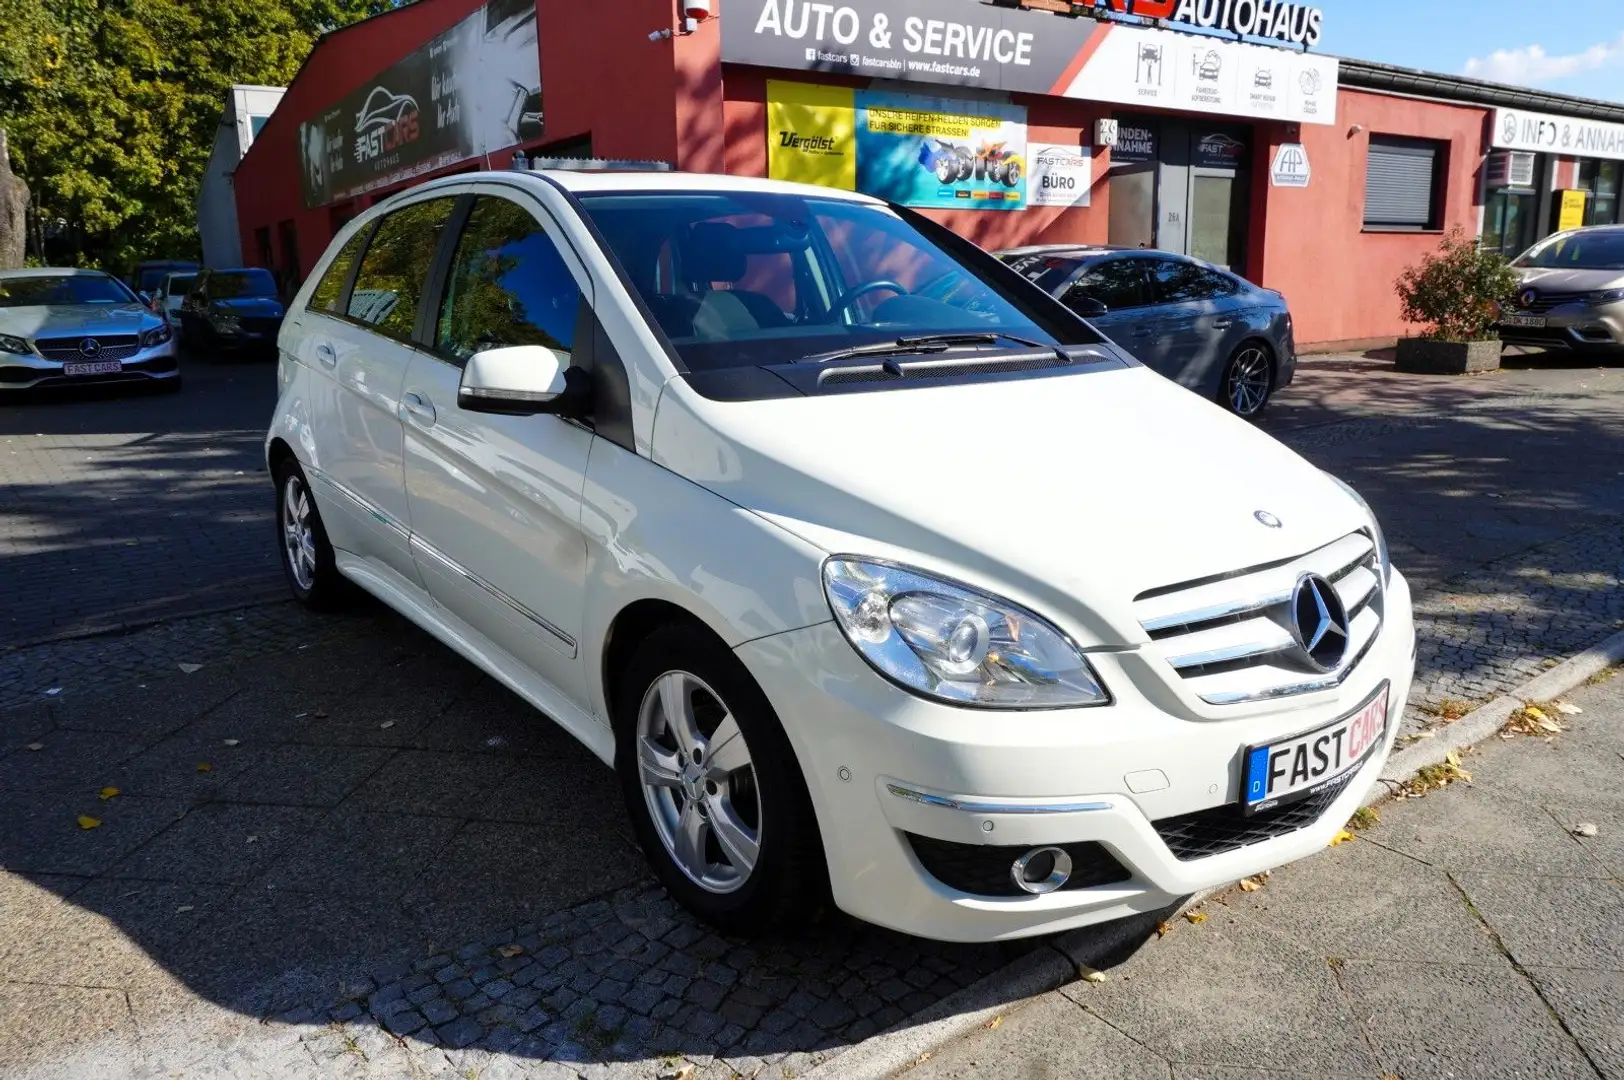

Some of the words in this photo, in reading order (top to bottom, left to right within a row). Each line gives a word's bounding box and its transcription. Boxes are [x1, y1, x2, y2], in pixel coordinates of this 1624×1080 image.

[755, 0, 859, 45] AUTO
[868, 12, 892, 49] &
[902, 16, 1034, 66] SERVICE
[1174, 0, 1323, 46] AUTOHAUS
[908, 60, 981, 78] www.fastcars.de
[869, 109, 906, 120] UNSERE
[905, 111, 969, 125] REIFEN-HELDEN
[970, 118, 1001, 129] SORGEN
[888, 121, 925, 133] SICHERE
[925, 124, 969, 137] STRASSEN!
[354, 109, 420, 163] FASTCARS
[779, 131, 834, 152] Vergölst
[1561, 124, 1572, 147] &
[1035, 157, 1084, 167] FASTCARS
[1042, 172, 1076, 190] BÜRO
[1252, 780, 1261, 793] D
